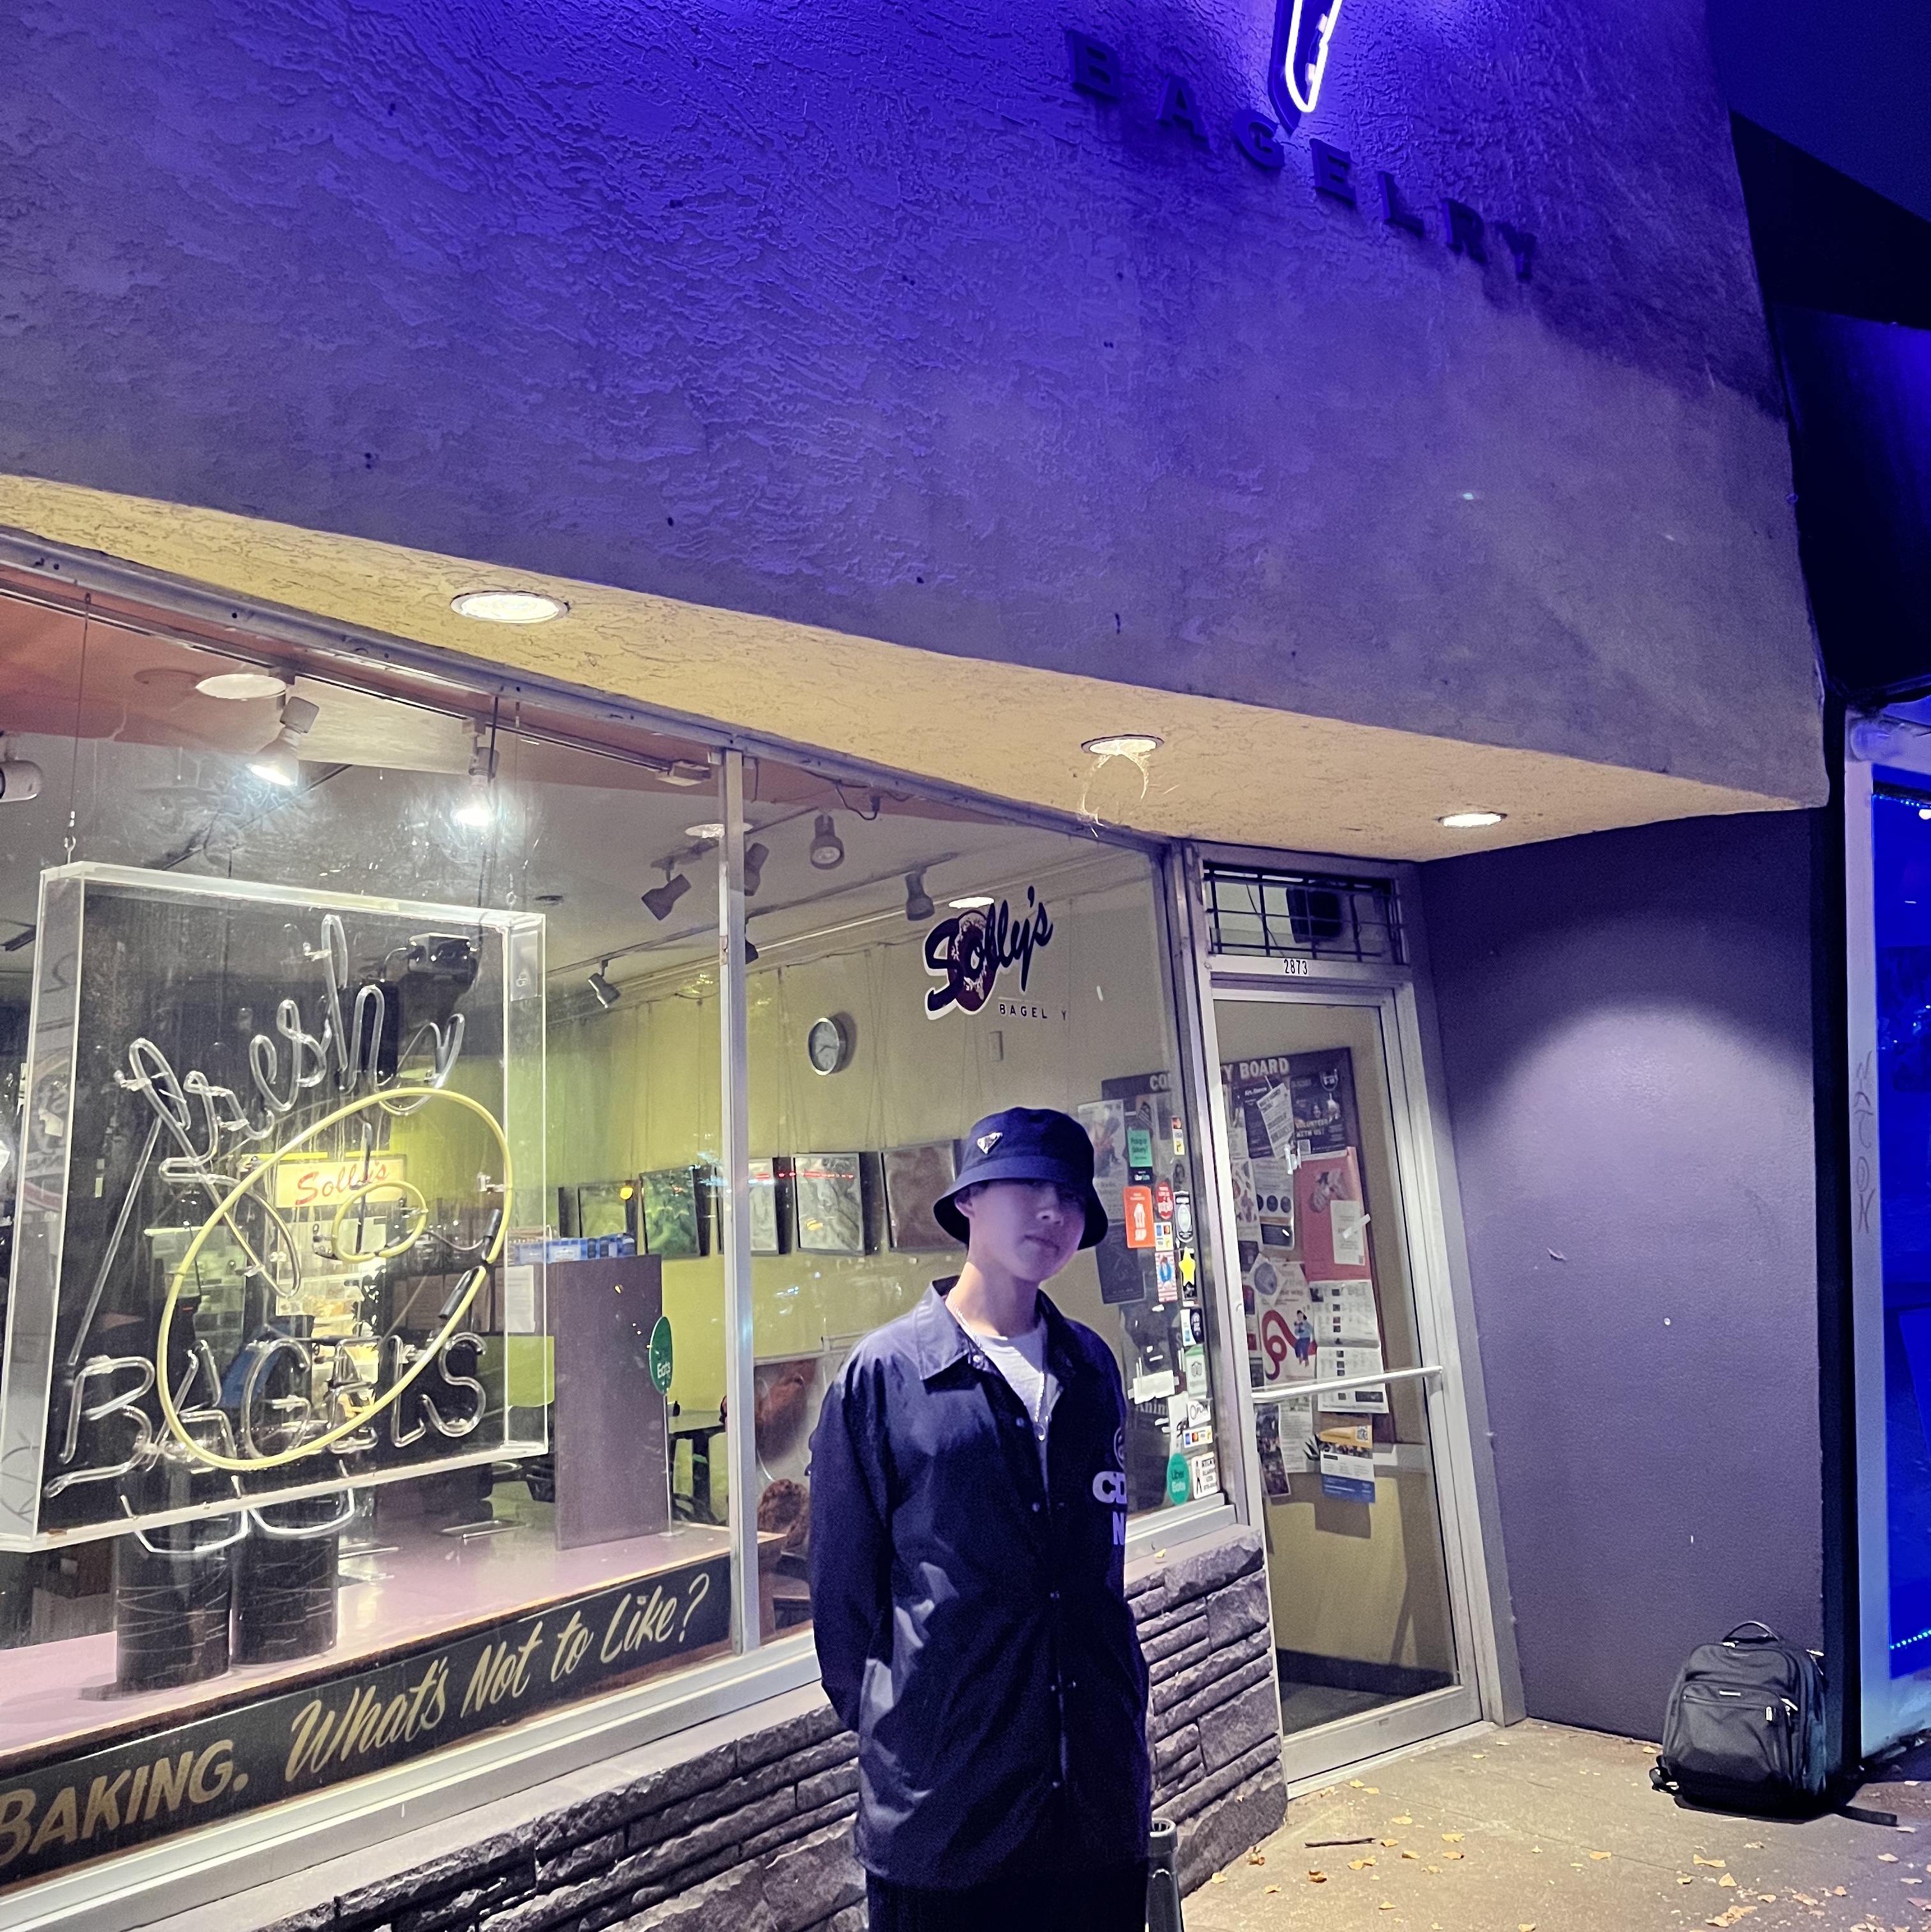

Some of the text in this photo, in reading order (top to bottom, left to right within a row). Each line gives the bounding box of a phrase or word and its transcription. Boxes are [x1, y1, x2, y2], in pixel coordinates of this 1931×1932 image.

[1066, 29, 1537, 280] BAGELRY
[923, 885, 1054, 1020] Solly's
[1284, 959, 1308, 975] 2873
[1239, 1056, 1290, 1080] BOARD
[43, 1330, 487, 1498] BAGELS
[0, 1572, 711, 1866] BAKING. What's Not to Like?
